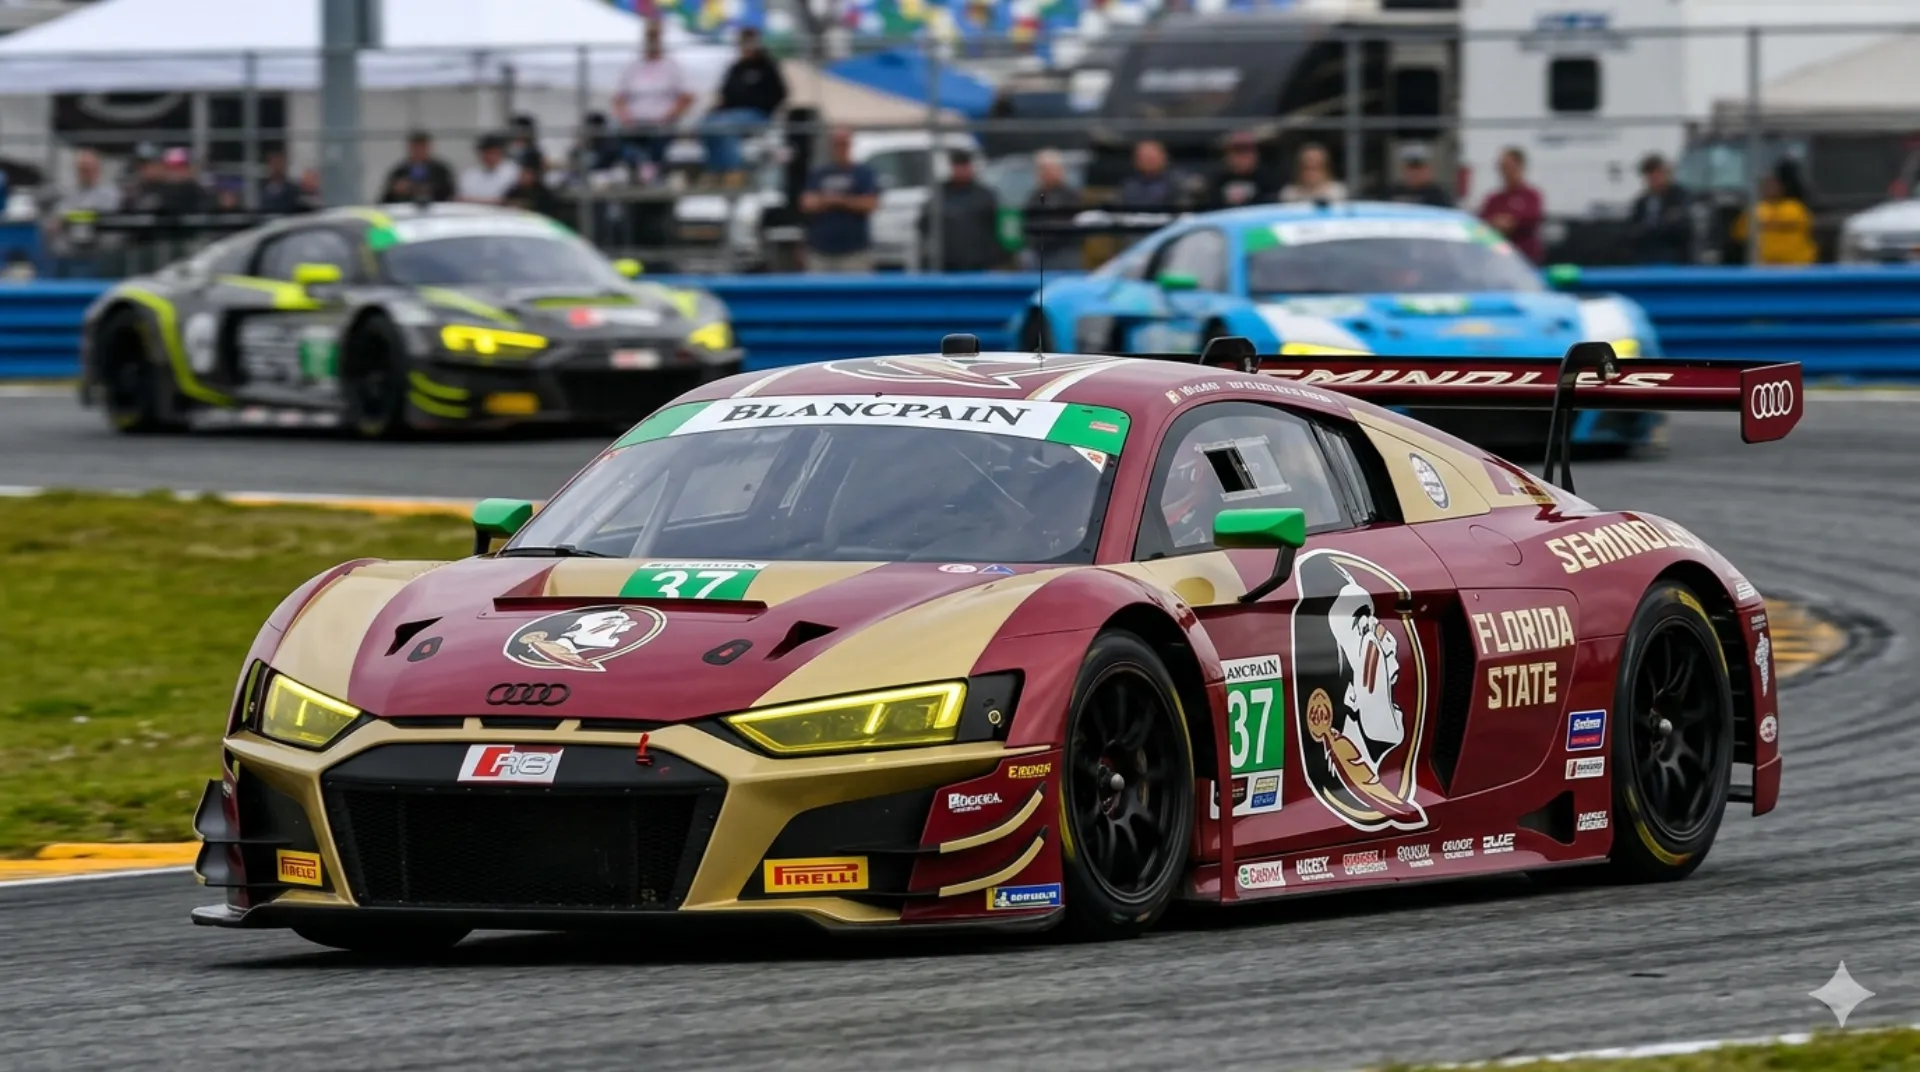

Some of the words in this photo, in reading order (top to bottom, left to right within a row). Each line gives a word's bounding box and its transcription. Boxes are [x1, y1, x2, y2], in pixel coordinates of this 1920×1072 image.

[720, 402, 1031, 426] BLANCPAIN
[1545, 519, 1702, 574] SEMINOLE
[652, 570, 739, 599] 37
[1471, 605, 1575, 655] FLORIDA
[1487, 661, 1557, 710] STATE
[1228, 687, 1274, 769] 37
[489, 751, 553, 776] R8
[774, 863, 859, 887] PIRELLI
